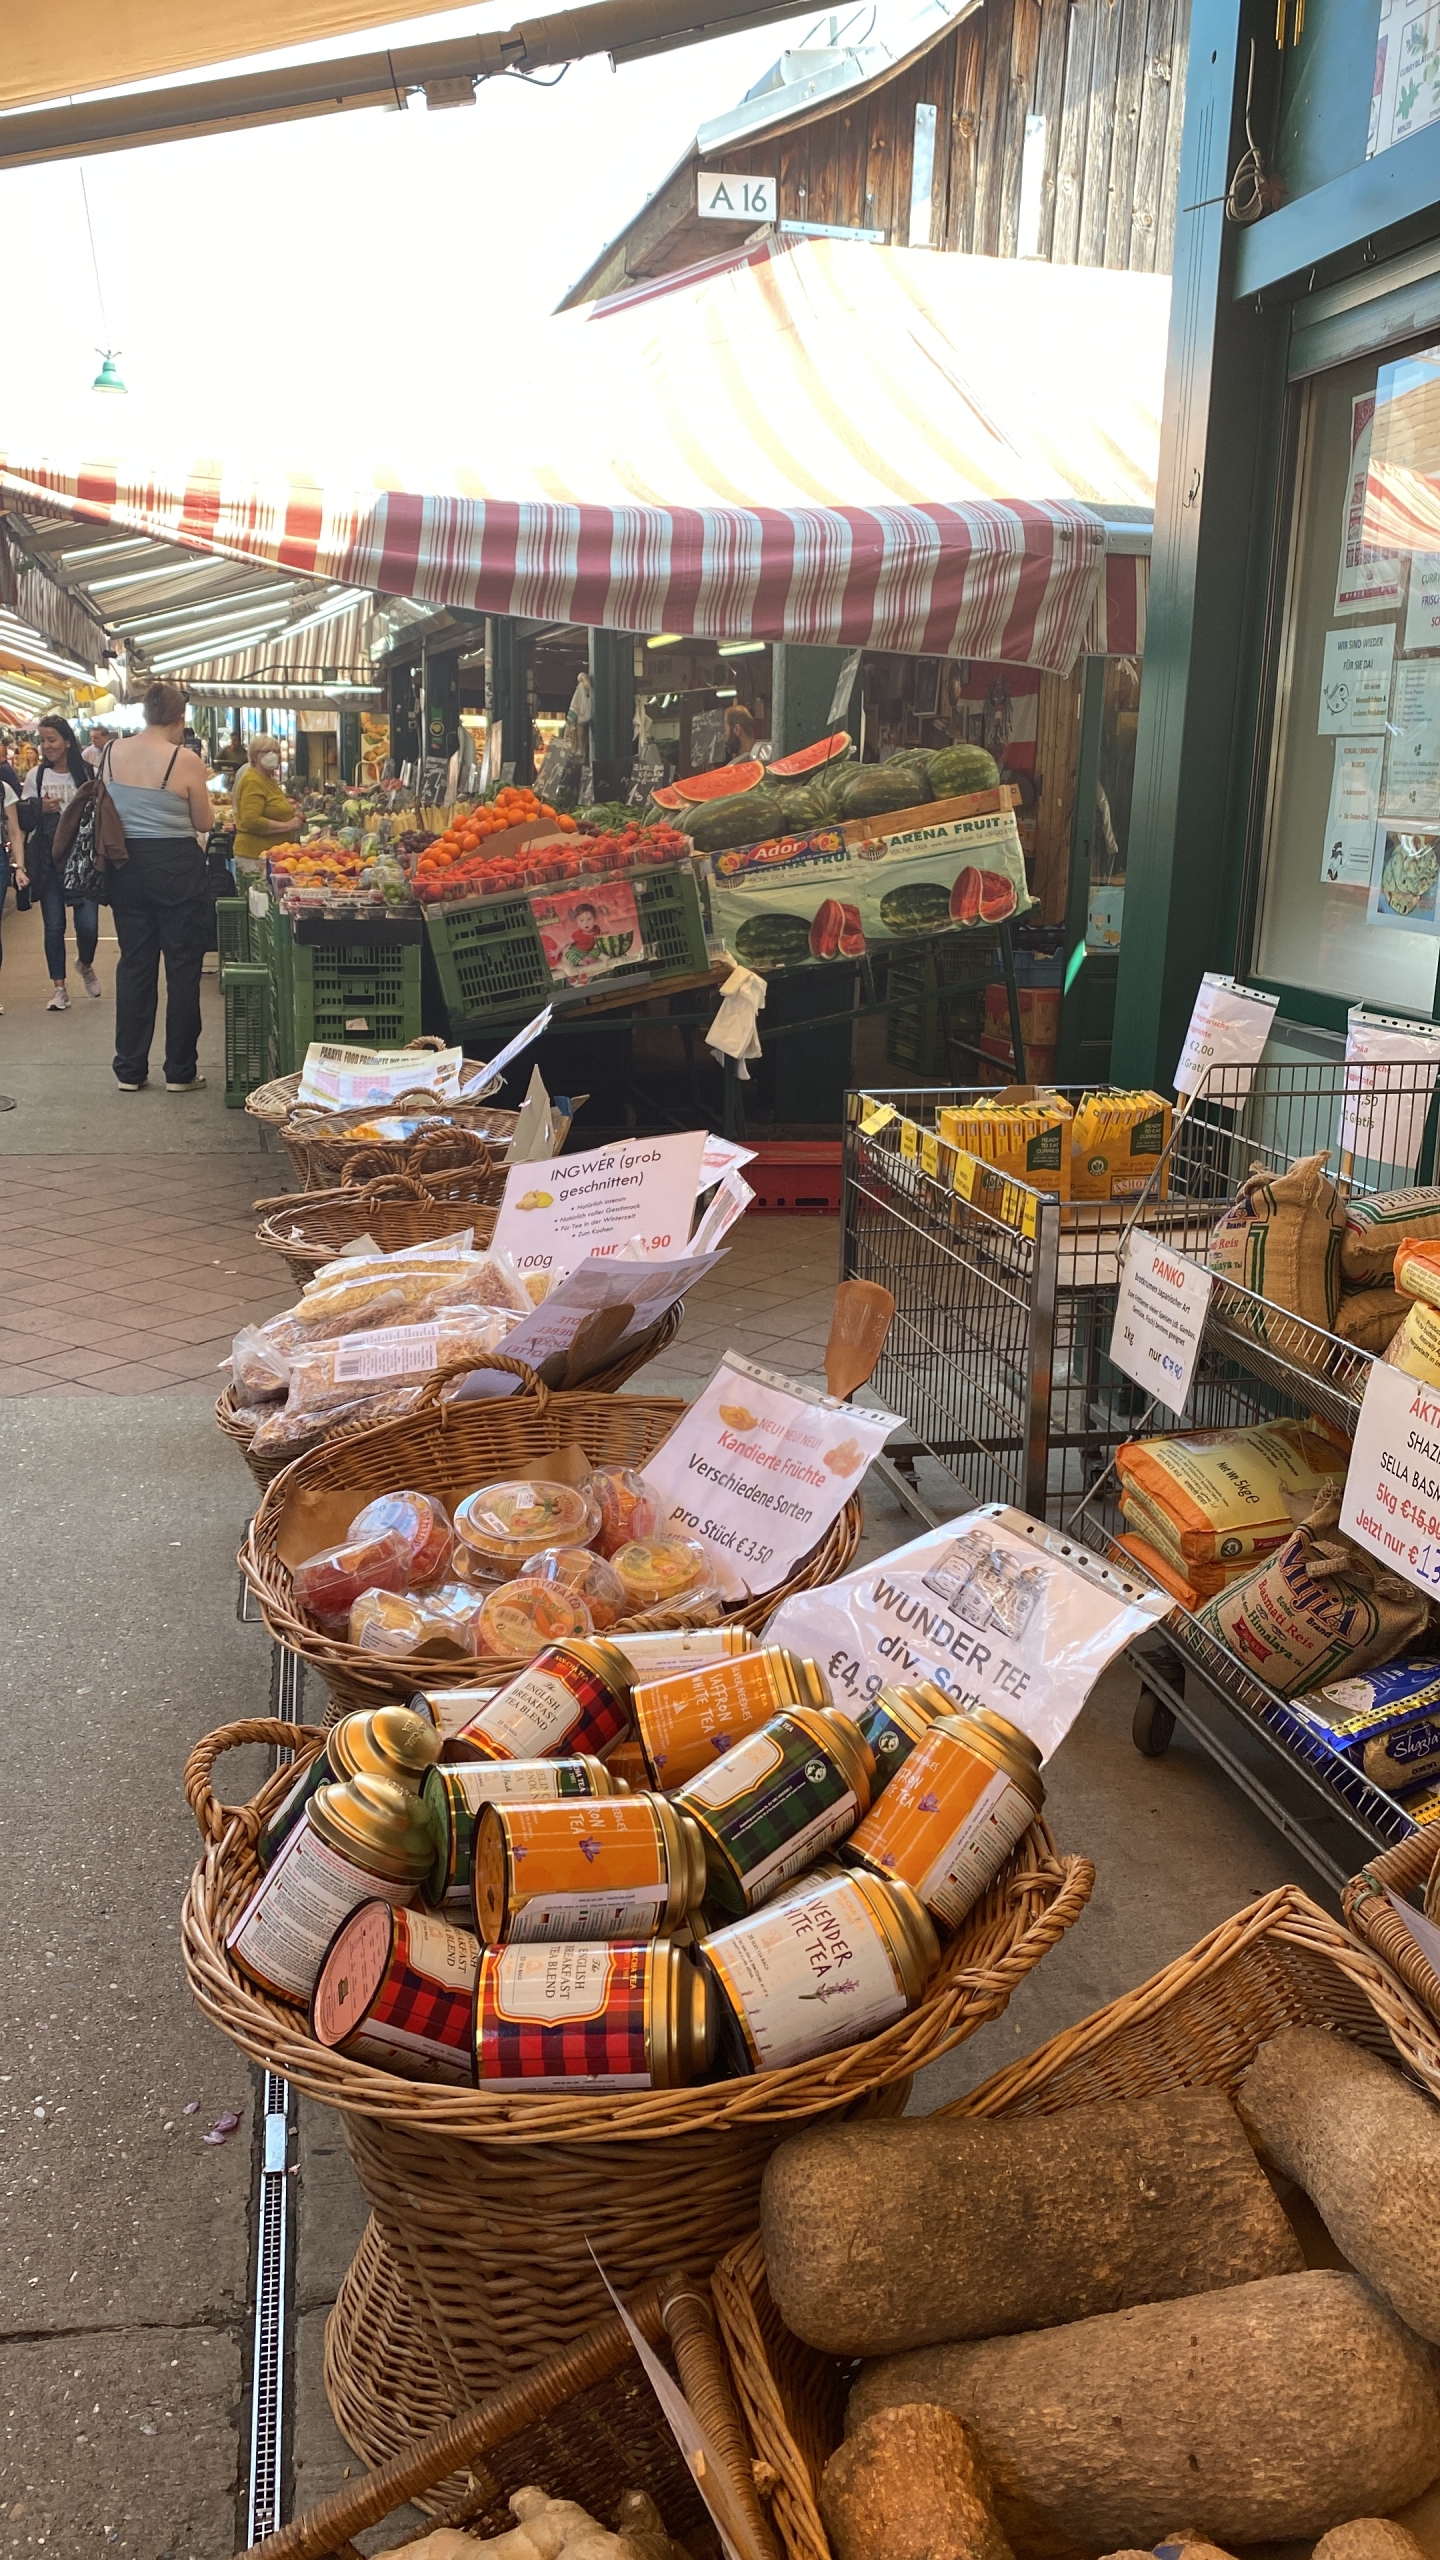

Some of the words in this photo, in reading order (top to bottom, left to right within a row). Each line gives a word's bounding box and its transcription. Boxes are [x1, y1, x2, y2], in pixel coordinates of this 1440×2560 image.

[709, 181, 734, 210] A
[743, 183, 767, 213] 16
[1338, 641, 1348, 651] WIR
[1349, 639, 1362, 649] SIND
[1363, 637, 1384, 648] WIEDER
[1343, 659, 1354, 671] FÜR
[1355, 660, 1363, 670] SIE
[890, 827, 949, 847] ARENA
[954, 817, 1001, 835] FRUIT
[754, 842, 803, 860] Ador
[890, 846, 911, 856] VERONA
[343, 1051, 360, 1064] FOOD
[359, 1055, 389, 1066] PRODUCTS
[1185, 1058, 1205, 1074] Grati
[1349, 1112, 1375, 1129] Gatis
[550, 1157, 615, 1182] INGWER
[619, 1149, 661, 1170] (grob
[559, 1171, 645, 1201] geschnitten)
[560, 1213, 586, 1223] Natürlich
[587, 1209, 604, 1217] voller
[605, 1203, 641, 1214] Geschmack
[577, 1199, 603, 1210] Natürlich
[603, 1213, 636, 1223] Winterzeit
[591, 1226, 614, 1234] Kochen
[1226, 1221, 1247, 1230] Brand
[516, 1254, 553, 1269] 100g
[590, 1243, 619, 1257] nur
[1218, 1238, 1239, 1249] Reis
[1151, 1257, 1185, 1288] PANKO
[1135, 1272, 1158, 1293] Brotkrumen
[1182, 1303, 1191, 1314] Art
[1124, 1325, 1135, 1346] 1kg
[1148, 1346, 1162, 1363] nur
[717, 1430, 782, 1473] Kandierte
[781, 1457, 826, 1488] Früchte
[1380, 1451, 1408, 1483] SELLA
[688, 1453, 774, 1509] Verschiedene
[773, 1495, 813, 1524] Sorten
[1216, 1461, 1230, 1473] Net
[1234, 1479, 1252, 1497] 5kg
[1376, 1482, 1398, 1515] 5kg
[669, 1505, 700, 1528] pro
[699, 1520, 736, 1551] Stück
[1356, 1509, 1383, 1541] Jetzt
[1383, 1530, 1406, 1556] nur
[549, 1603, 567, 1615] DICE
[1258, 1578, 1287, 1625] Basmati
[1286, 1623, 1314, 1649] Reis
[872, 1578, 992, 1675] WUNDER
[992, 1659, 1031, 1700] TEE
[1248, 1610, 1294, 1660] Himalaya
[1306, 1617, 1333, 1639] Brand
[877, 1635, 920, 1678] div.
[578, 1669, 589, 1682] TEA
[692, 1675, 710, 1706] WHITE
[511, 1688, 558, 1725] BREAKFAST
[525, 1682, 561, 1711] ENGLISH
[708, 1673, 733, 1722] SAFFRON
[736, 1686, 753, 1722] NEEDLES
[505, 1696, 519, 1710] TEA
[520, 1706, 548, 1732] BLEND
[699, 1708, 716, 1734] TEA
[782, 1721, 795, 1733] TEA
[1394, 1732, 1439, 1757] Shazia
[1412, 1761, 1437, 1775] OMNI
[577, 1777, 586, 1794] TEA
[896, 1790, 916, 1809] TEA
[569, 1813, 586, 1835] TEA
[444, 1932, 456, 1967] BLEND
[549, 1945, 561, 1960] TEA
[805, 1937, 833, 1978] TEA
[545, 1960, 559, 1999] BLEND
[559, 1944, 576, 2000] BREAKFAST
[574, 1948, 589, 1990] ENGLISH
[628, 1972, 639, 1990] TEA
